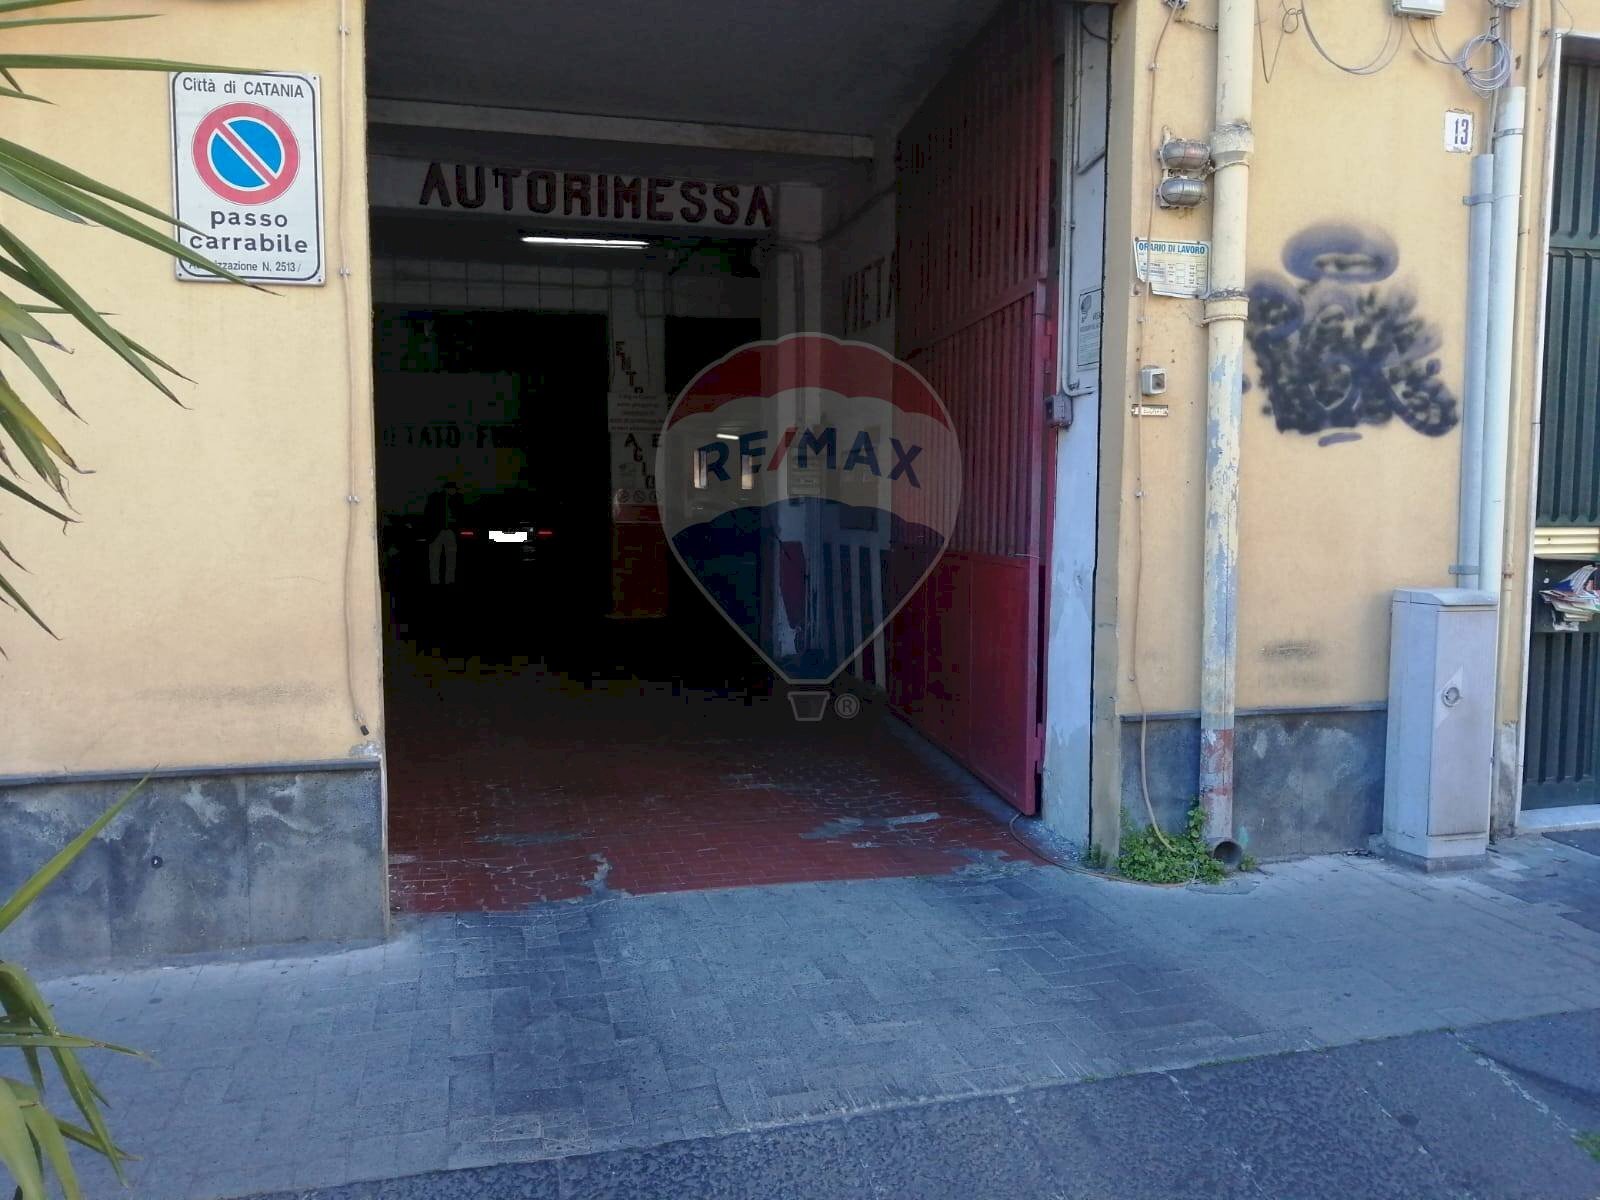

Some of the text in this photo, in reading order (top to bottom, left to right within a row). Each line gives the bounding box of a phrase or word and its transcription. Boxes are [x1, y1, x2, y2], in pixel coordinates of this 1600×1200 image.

[182, 77, 305, 99] Città di CATANIA
[1454, 118, 1470, 144] 13
[418, 161, 774, 228] AUTORIMESSA
[210, 209, 289, 230] passo
[189, 233, 309, 254] carrabile
[1138, 242, 1206, 255] ORARIO DI LAVORO
[188, 259, 258, 271] izzazione
